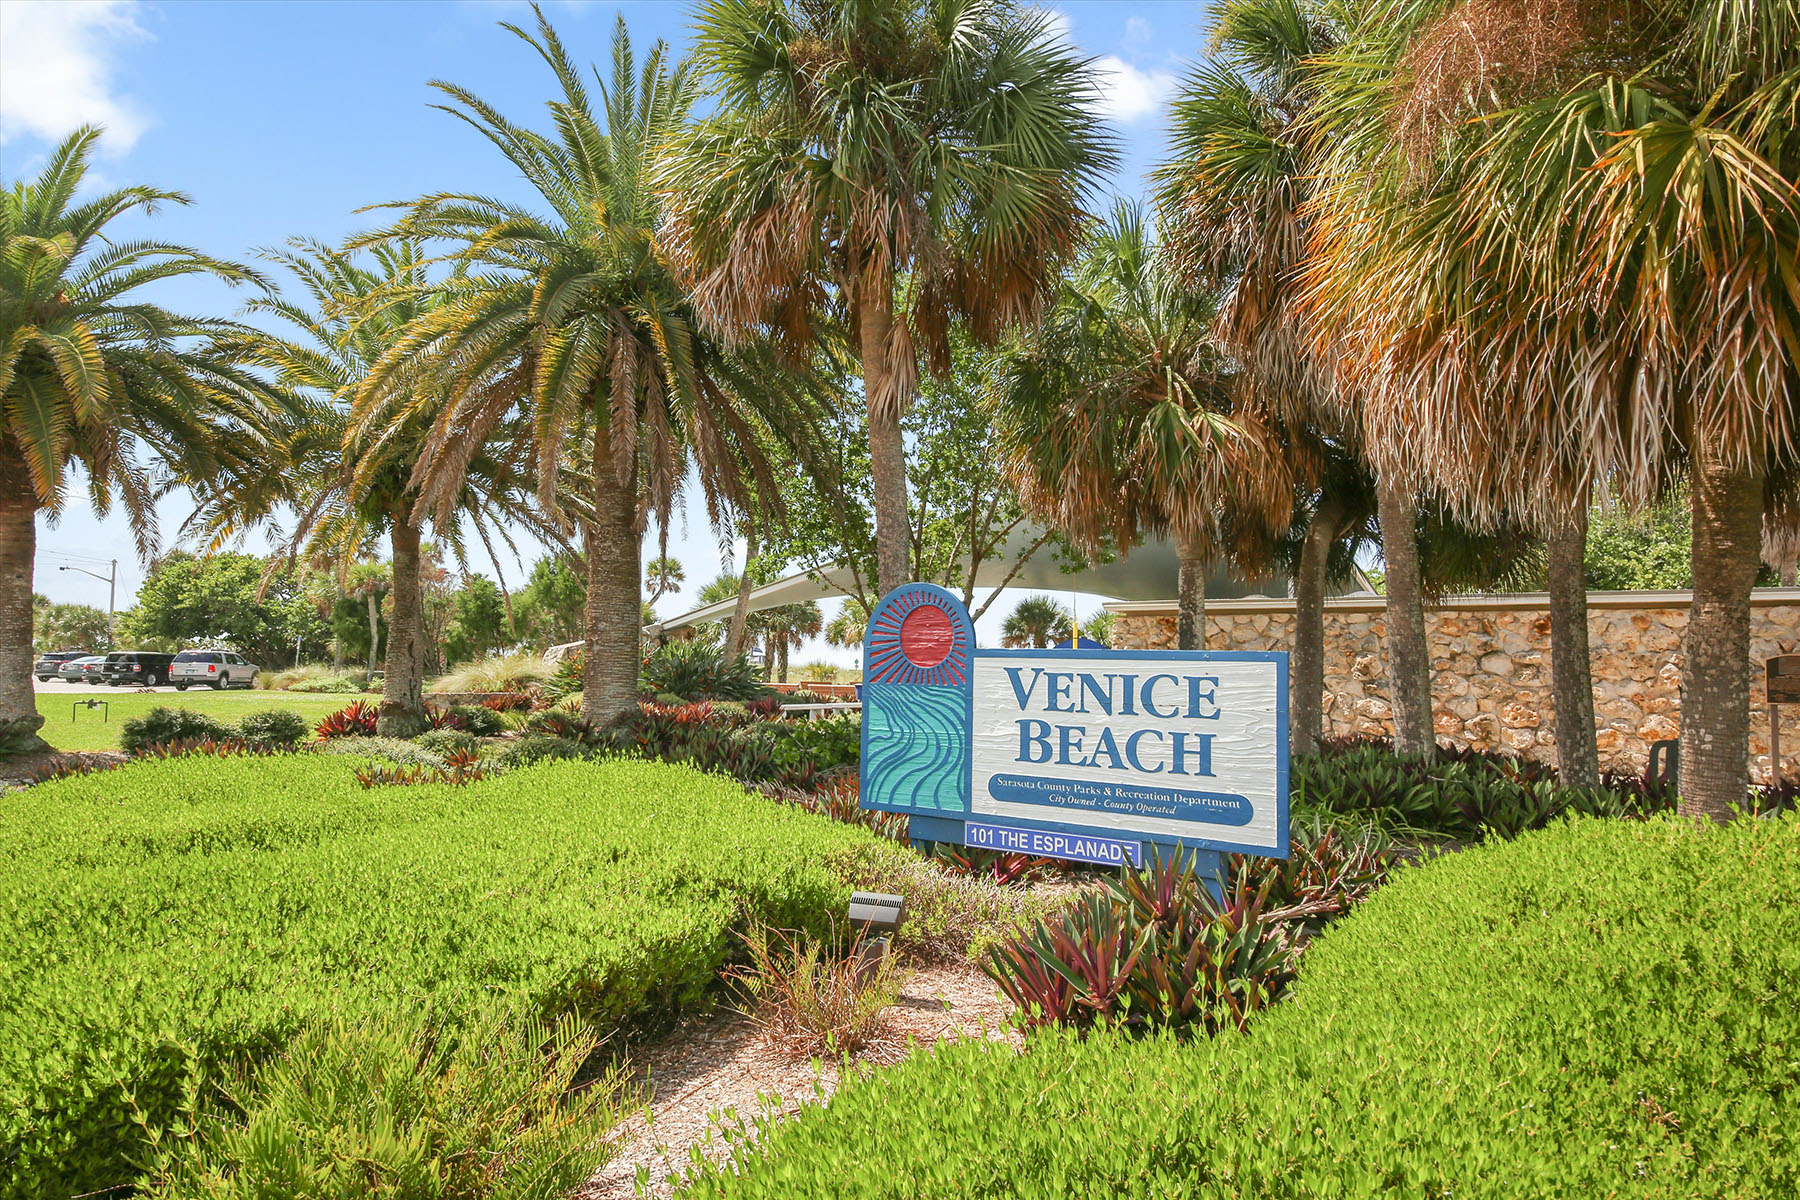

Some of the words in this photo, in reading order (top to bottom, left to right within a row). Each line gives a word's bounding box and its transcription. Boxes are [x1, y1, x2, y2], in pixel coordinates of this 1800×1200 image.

[1003, 667, 1221, 720] VENICE
[1015, 719, 1217, 777] BEACH
[997, 777, 1035, 789] Sarasota
[1037, 781, 1072, 794] County
[1074, 784, 1101, 795] Parks
[1103, 787, 1112, 796] &
[1115, 788, 1170, 802] Recreation
[1174, 793, 1241, 809] Department
[1048, 794, 1066, 805] City
[1067, 795, 1097, 806] Owned
[1103, 799, 1135, 812] County
[1136, 802, 1177, 815] Operated
[971, 827, 993, 845] 101
[999, 831, 1029, 849] THE
